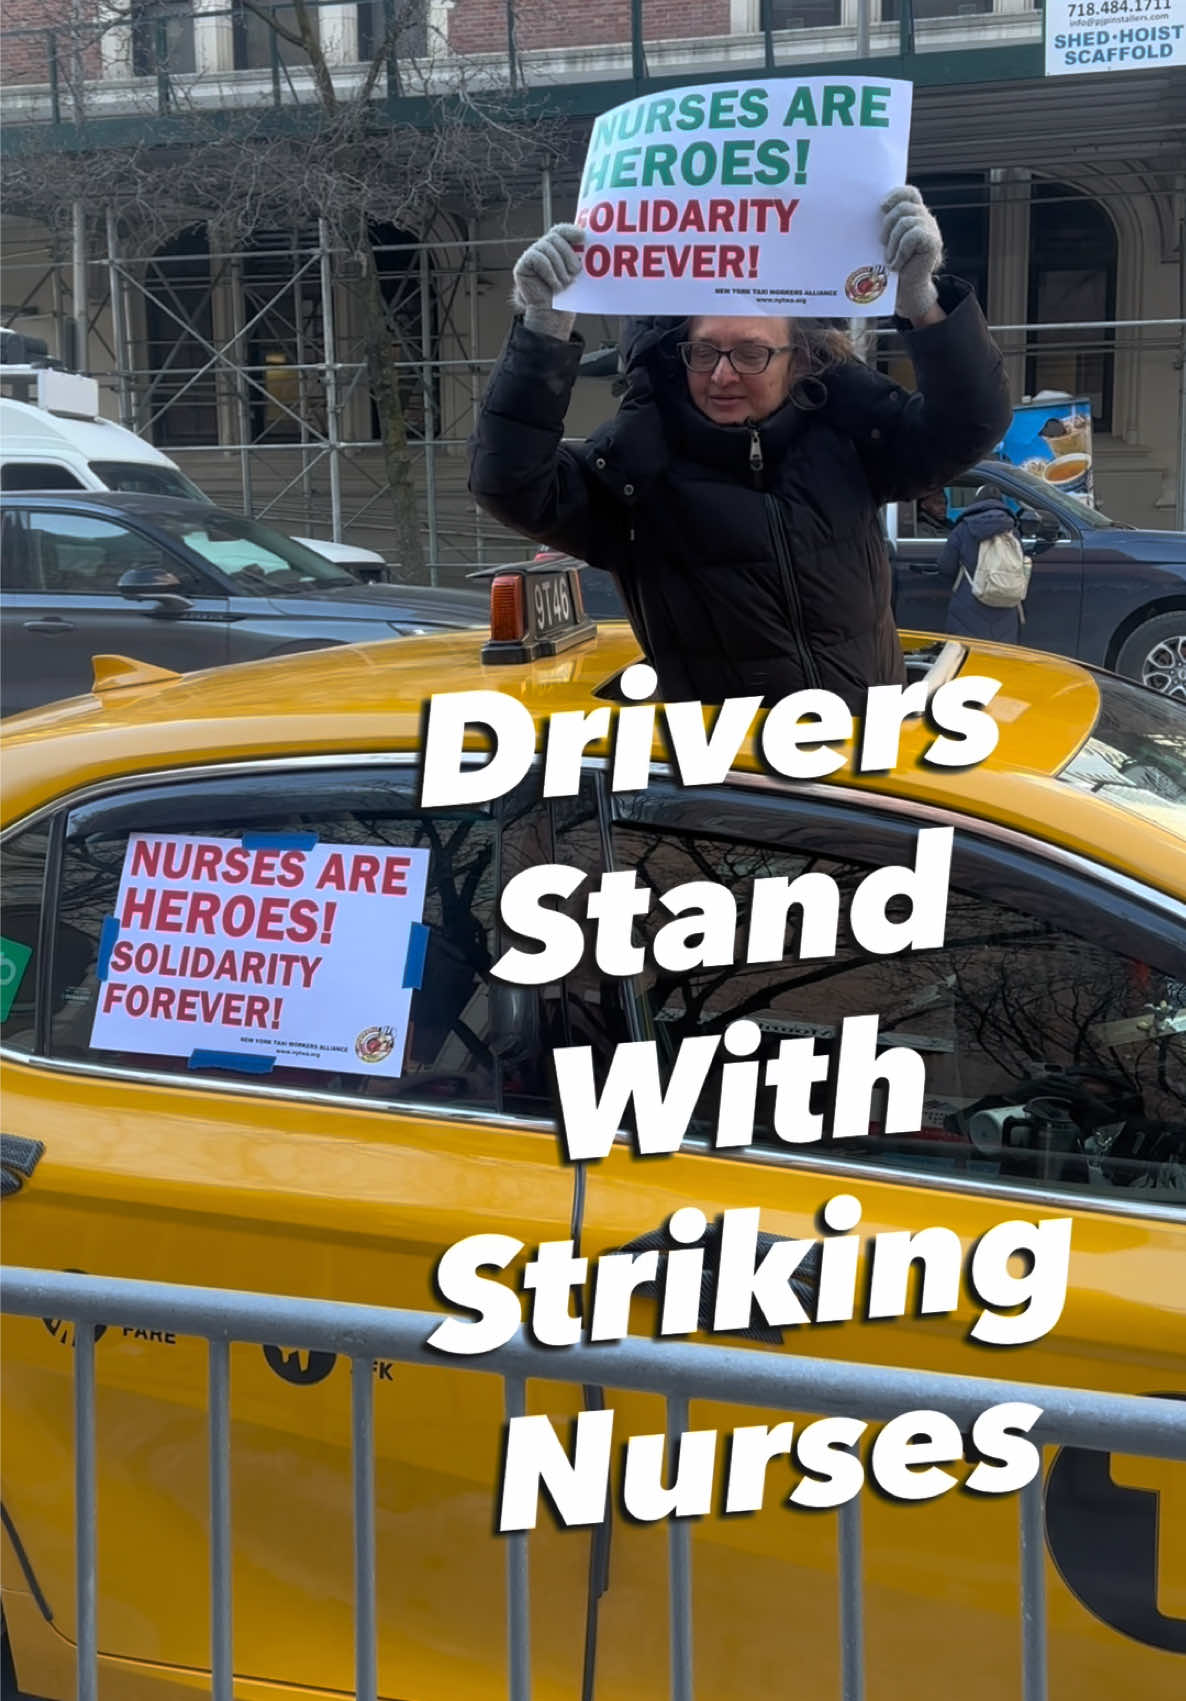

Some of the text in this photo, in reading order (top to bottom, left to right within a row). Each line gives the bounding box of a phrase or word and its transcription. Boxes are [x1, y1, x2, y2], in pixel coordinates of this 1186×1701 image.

[1067, 0, 1172, 17] 718.484.1711
[1064, 43, 1174, 65] SCAFFOLD
[594, 85, 893, 152] NURSES ARE
[582, 139, 811, 199] HEROES!
[131, 840, 412, 896] NURSES ARE
[120, 887, 338, 945] HEROES!
[110, 941, 323, 988] SOLIDARITY
[102, 983, 284, 1030] FOREVER!
